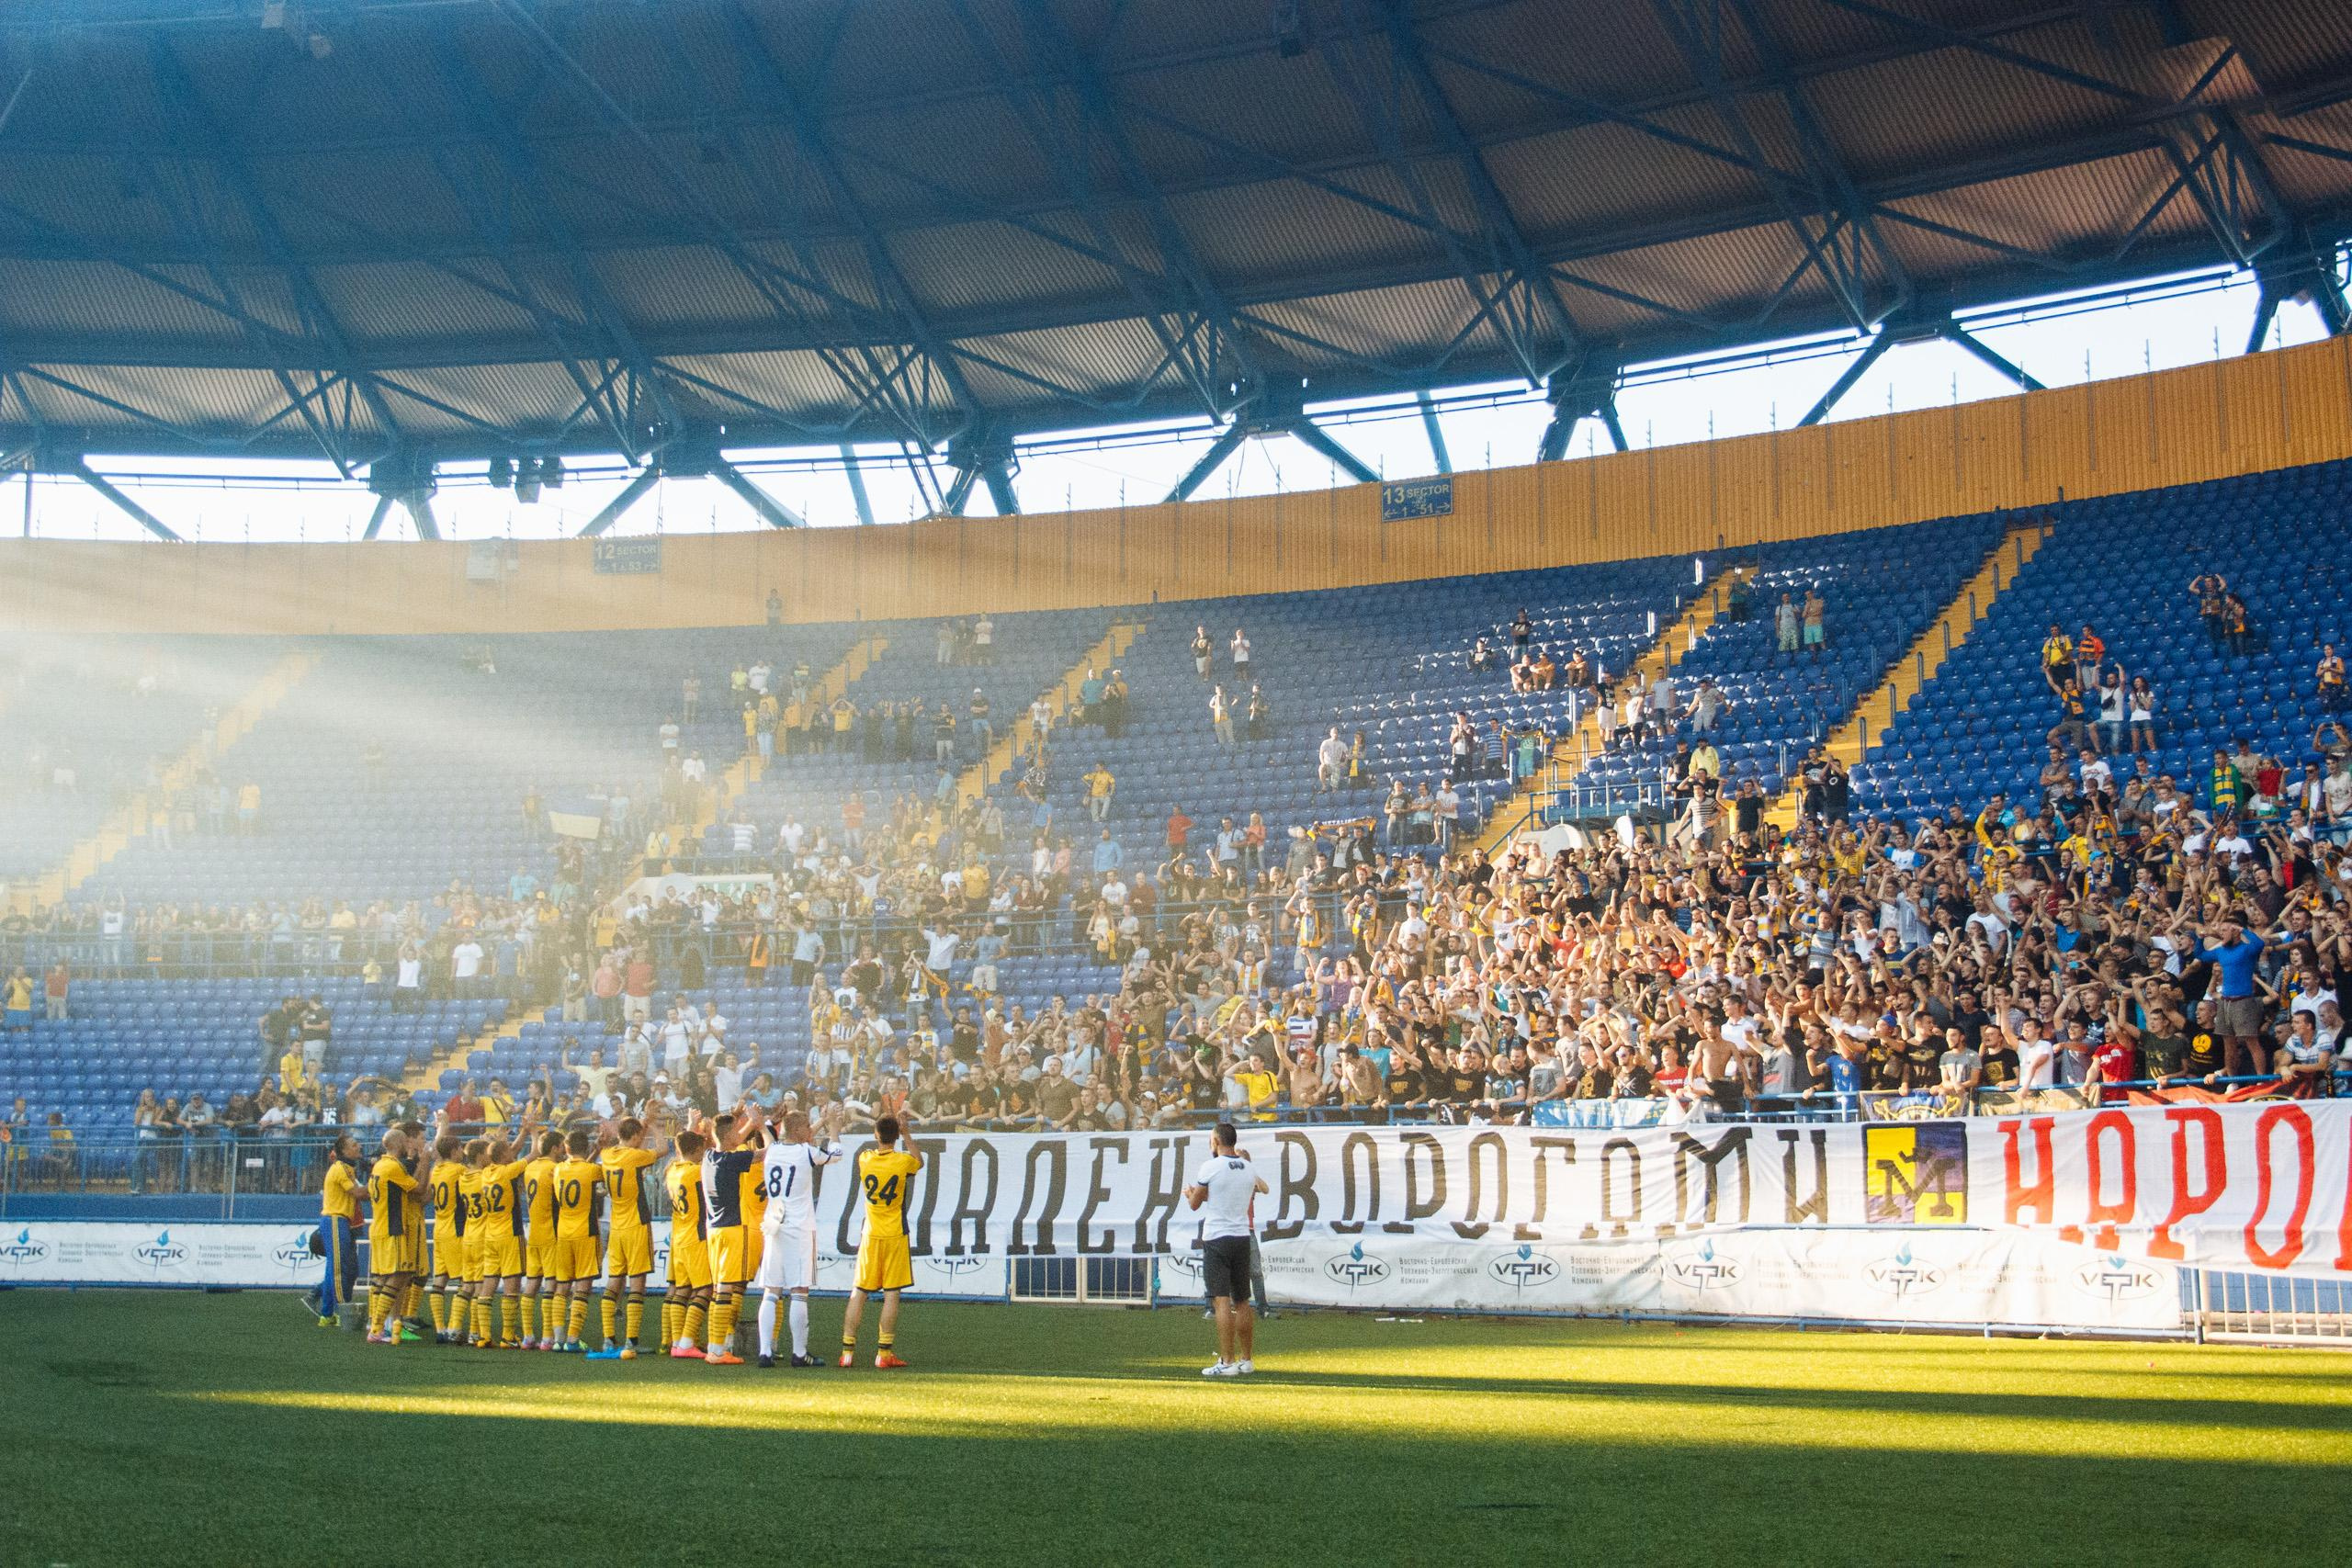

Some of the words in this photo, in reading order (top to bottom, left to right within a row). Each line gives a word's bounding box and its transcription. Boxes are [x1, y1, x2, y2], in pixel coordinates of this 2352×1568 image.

[1383, 487, 1405, 504] 13
[1407, 484, 1450, 498] SECTOR
[595, 543, 615, 559] 12
[559, 1179, 581, 1208] 10
[606, 1168, 624, 1198] 17
[768, 1165, 796, 1198] 81
[865, 1174, 899, 1206] 24
[1997, 1103, 2352, 1270] НАРО
